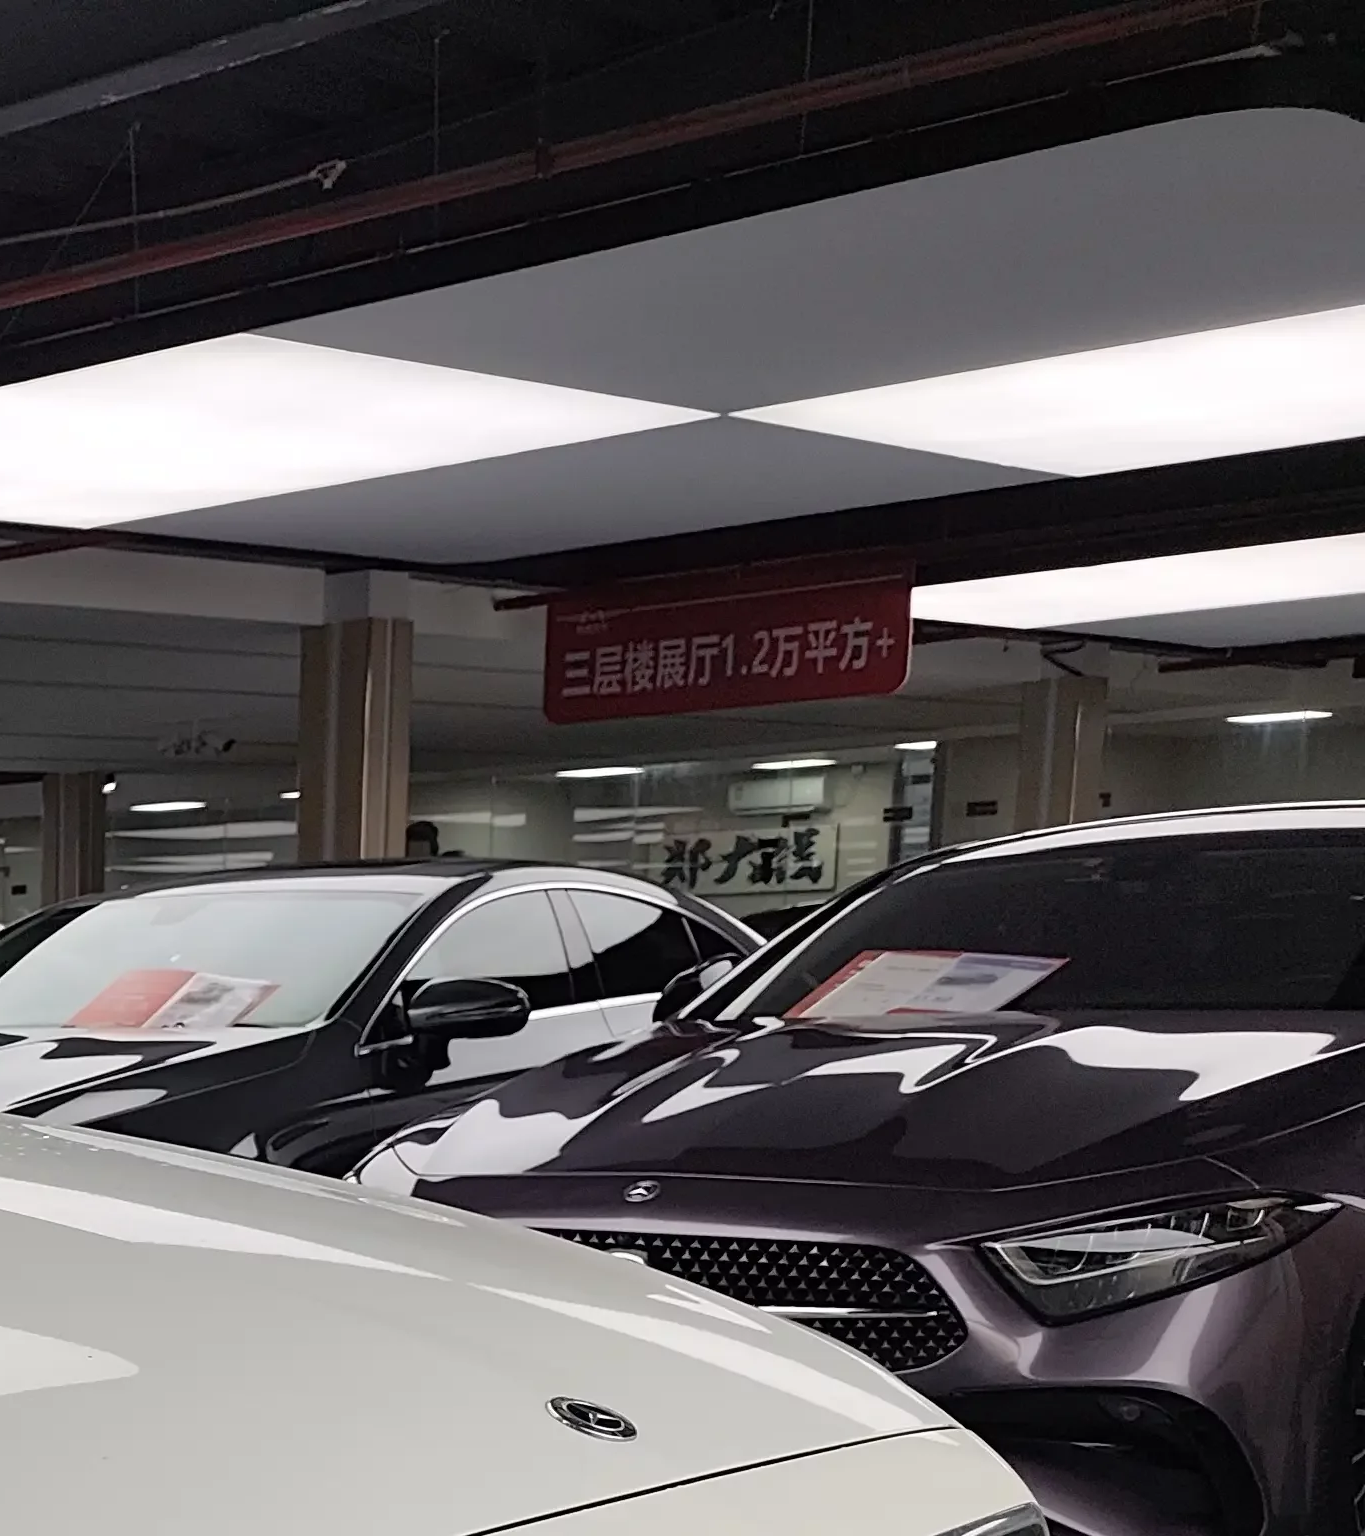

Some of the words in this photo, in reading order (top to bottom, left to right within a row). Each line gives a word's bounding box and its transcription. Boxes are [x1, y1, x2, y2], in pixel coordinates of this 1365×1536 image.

[561, 616, 897, 698] 三层楼展厅1.2万平方+
